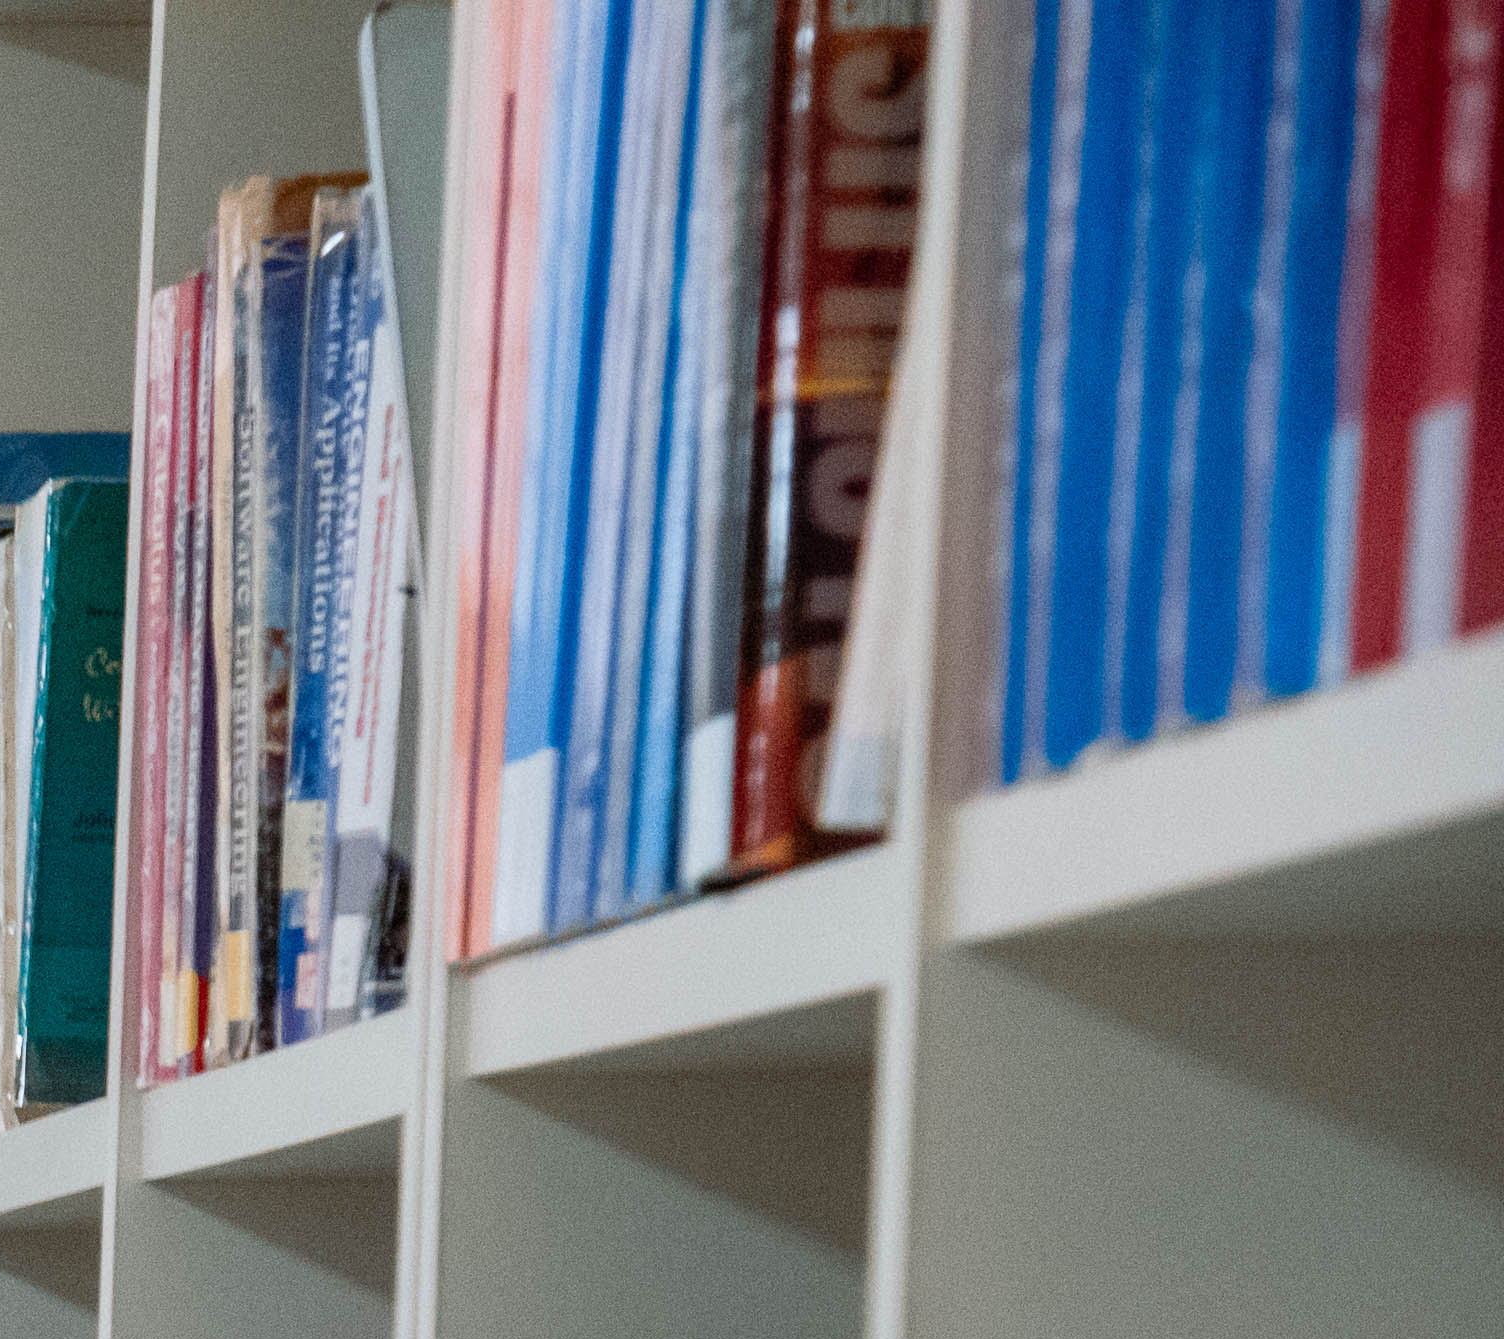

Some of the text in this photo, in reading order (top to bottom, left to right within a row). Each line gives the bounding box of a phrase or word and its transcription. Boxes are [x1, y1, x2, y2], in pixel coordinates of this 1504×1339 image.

[229, 406, 255, 898] Software Engineering
[308, 394, 342, 674] Applications
[328, 337, 370, 768] ENGINEERING
